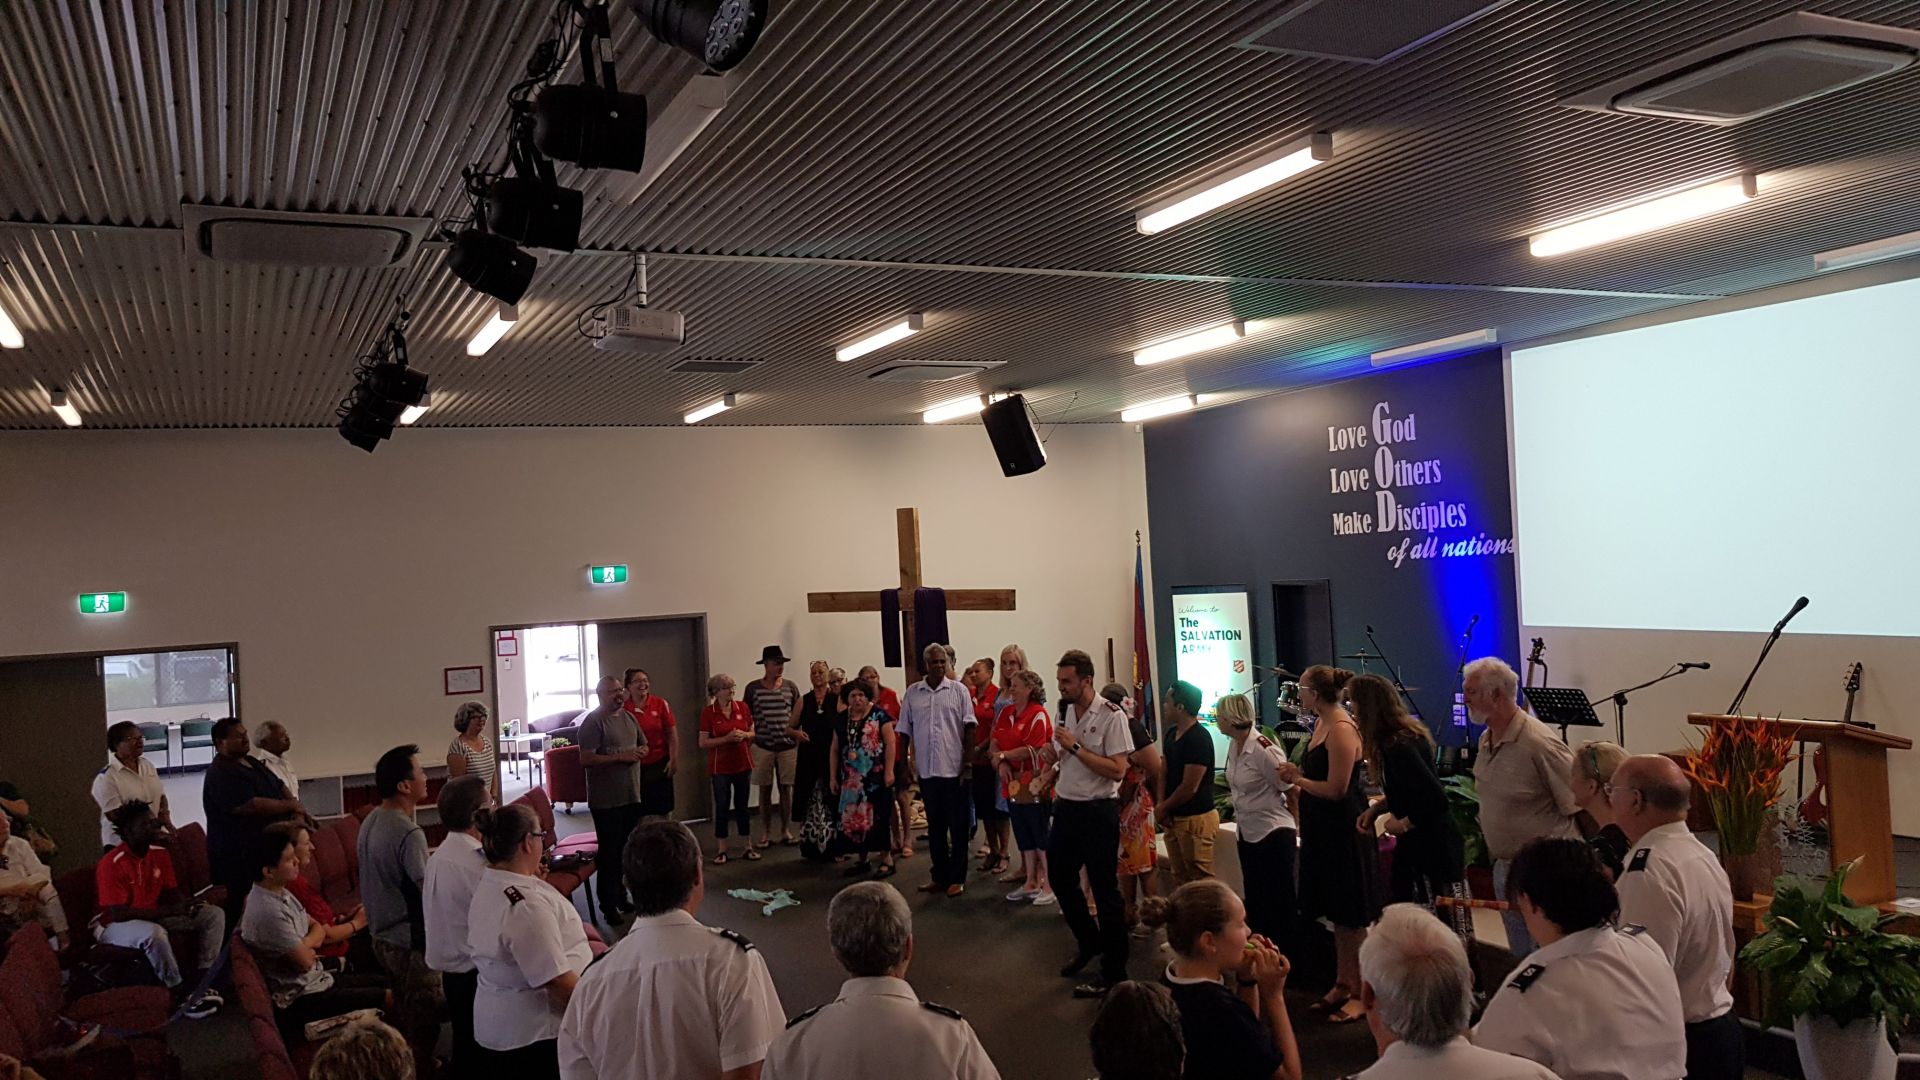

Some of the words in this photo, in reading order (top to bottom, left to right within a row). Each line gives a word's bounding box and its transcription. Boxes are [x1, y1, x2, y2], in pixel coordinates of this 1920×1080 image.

[1328, 426, 1367, 452] Love
[1372, 401, 1416, 445] God
[1330, 468, 1369, 493] Love
[1374, 446, 1441, 488] Others
[1333, 511, 1372, 535] Make
[1375, 490, 1467, 532] Disciples
[1387, 537, 1410, 568] of
[1410, 536, 1438, 559] all
[1179, 617, 1199, 628] The
[1180, 629, 1242, 641] SALVATION
